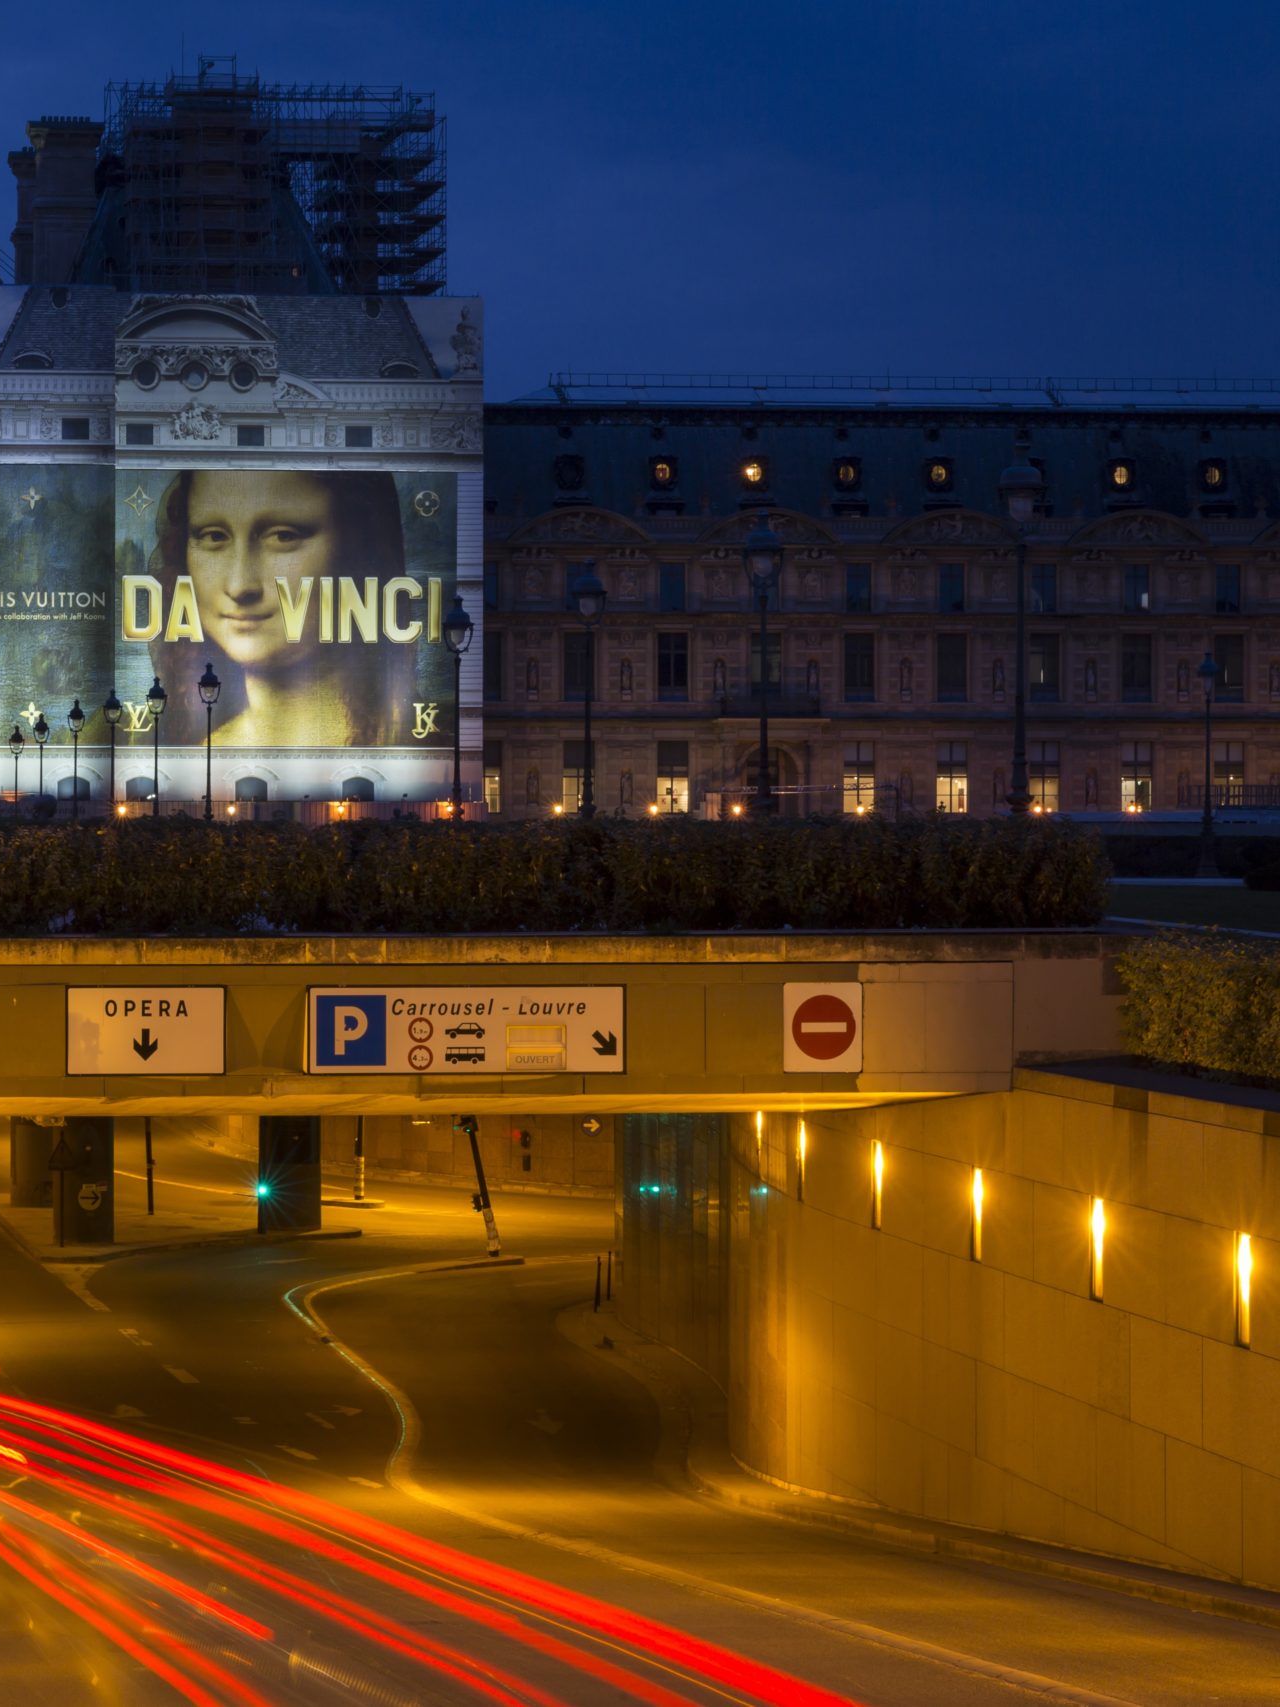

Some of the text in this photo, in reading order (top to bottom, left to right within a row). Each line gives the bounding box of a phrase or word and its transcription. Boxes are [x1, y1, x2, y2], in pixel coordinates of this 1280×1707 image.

[22, 591, 106, 608] VUITTON
[3, 611, 51, 620] collaboration
[53, 612, 68, 621] with
[69, 612, 83, 621] Jeff
[121, 575, 443, 644] DA VINCI
[104, 999, 190, 1018] OPERA
[391, 997, 494, 1017] Carrousel
[518, 998, 587, 1016] Louvre
[334, 1005, 369, 1056] P
[514, 1055, 556, 1065] OUVERT
